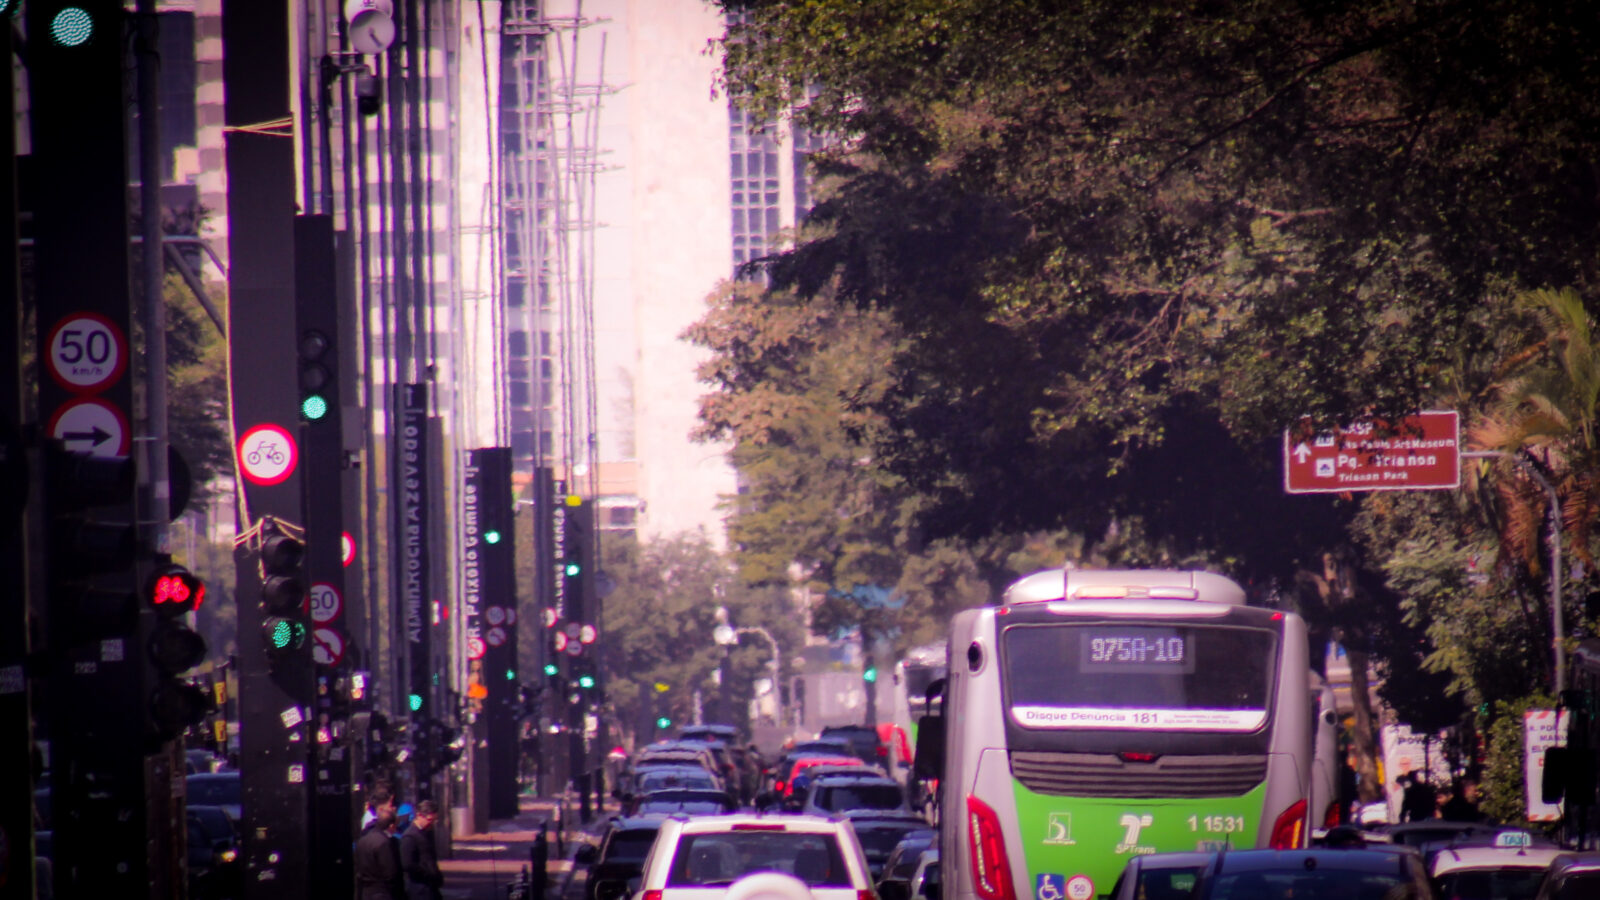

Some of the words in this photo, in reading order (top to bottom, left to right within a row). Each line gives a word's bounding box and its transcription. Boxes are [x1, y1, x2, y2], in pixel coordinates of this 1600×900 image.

[59, 329, 110, 364] 50
[1384, 469, 1409, 479] Park
[1091, 637, 1183, 661] 975A-10
[1026, 710, 1067, 721] Disque
[1133, 713, 1159, 724] 181
[1203, 816, 1245, 833] 1531
[1504, 836, 1528, 845] TAXI
[1115, 843, 1156, 855] SPTrans
[1073, 883, 1086, 894] 50
